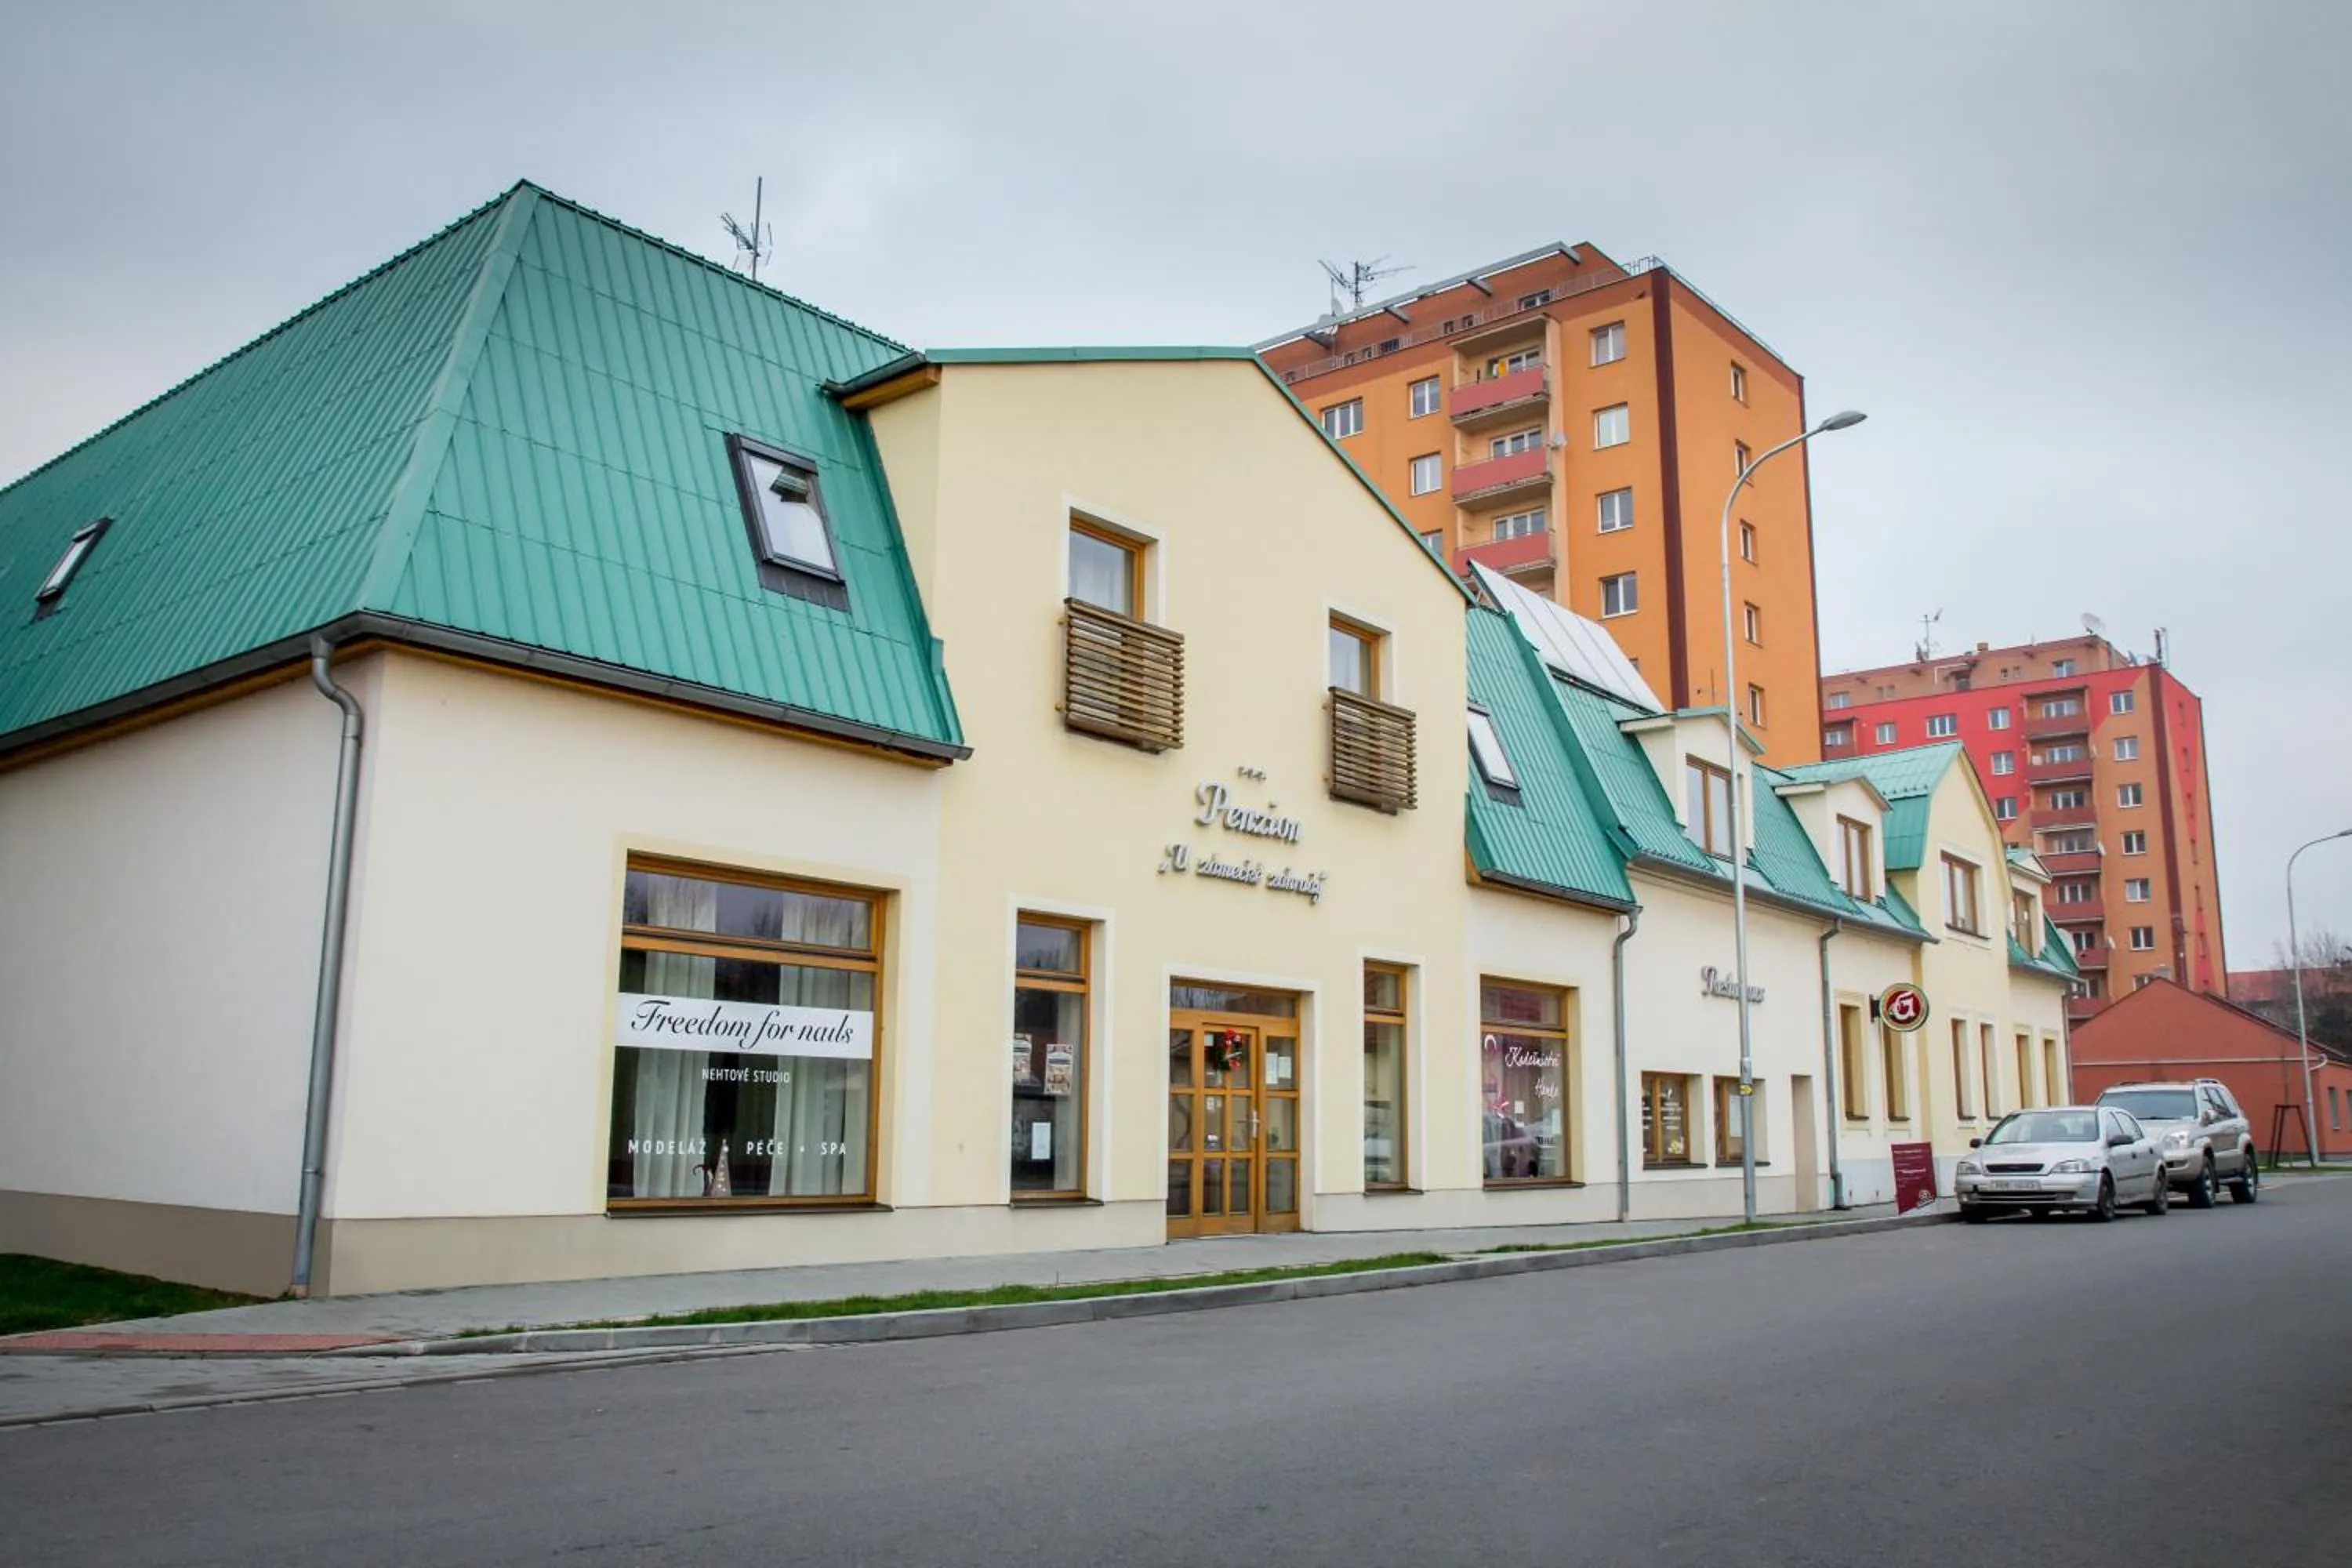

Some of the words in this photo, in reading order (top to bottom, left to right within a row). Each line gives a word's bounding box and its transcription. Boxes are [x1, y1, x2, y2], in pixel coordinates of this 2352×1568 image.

[1194, 778, 1301, 844] Penzion
[631, 1000, 752, 1038] Freedom
[739, 1009, 794, 1048] for
[797, 1014, 854, 1044] nails
[702, 1067, 749, 1082] NEHTOVÉ
[753, 1069, 791, 1083] STUDIO
[628, 1138, 706, 1155] MODELÁŽ
[746, 1139, 784, 1155] PÉČE
[820, 1142, 847, 1155] SPA
